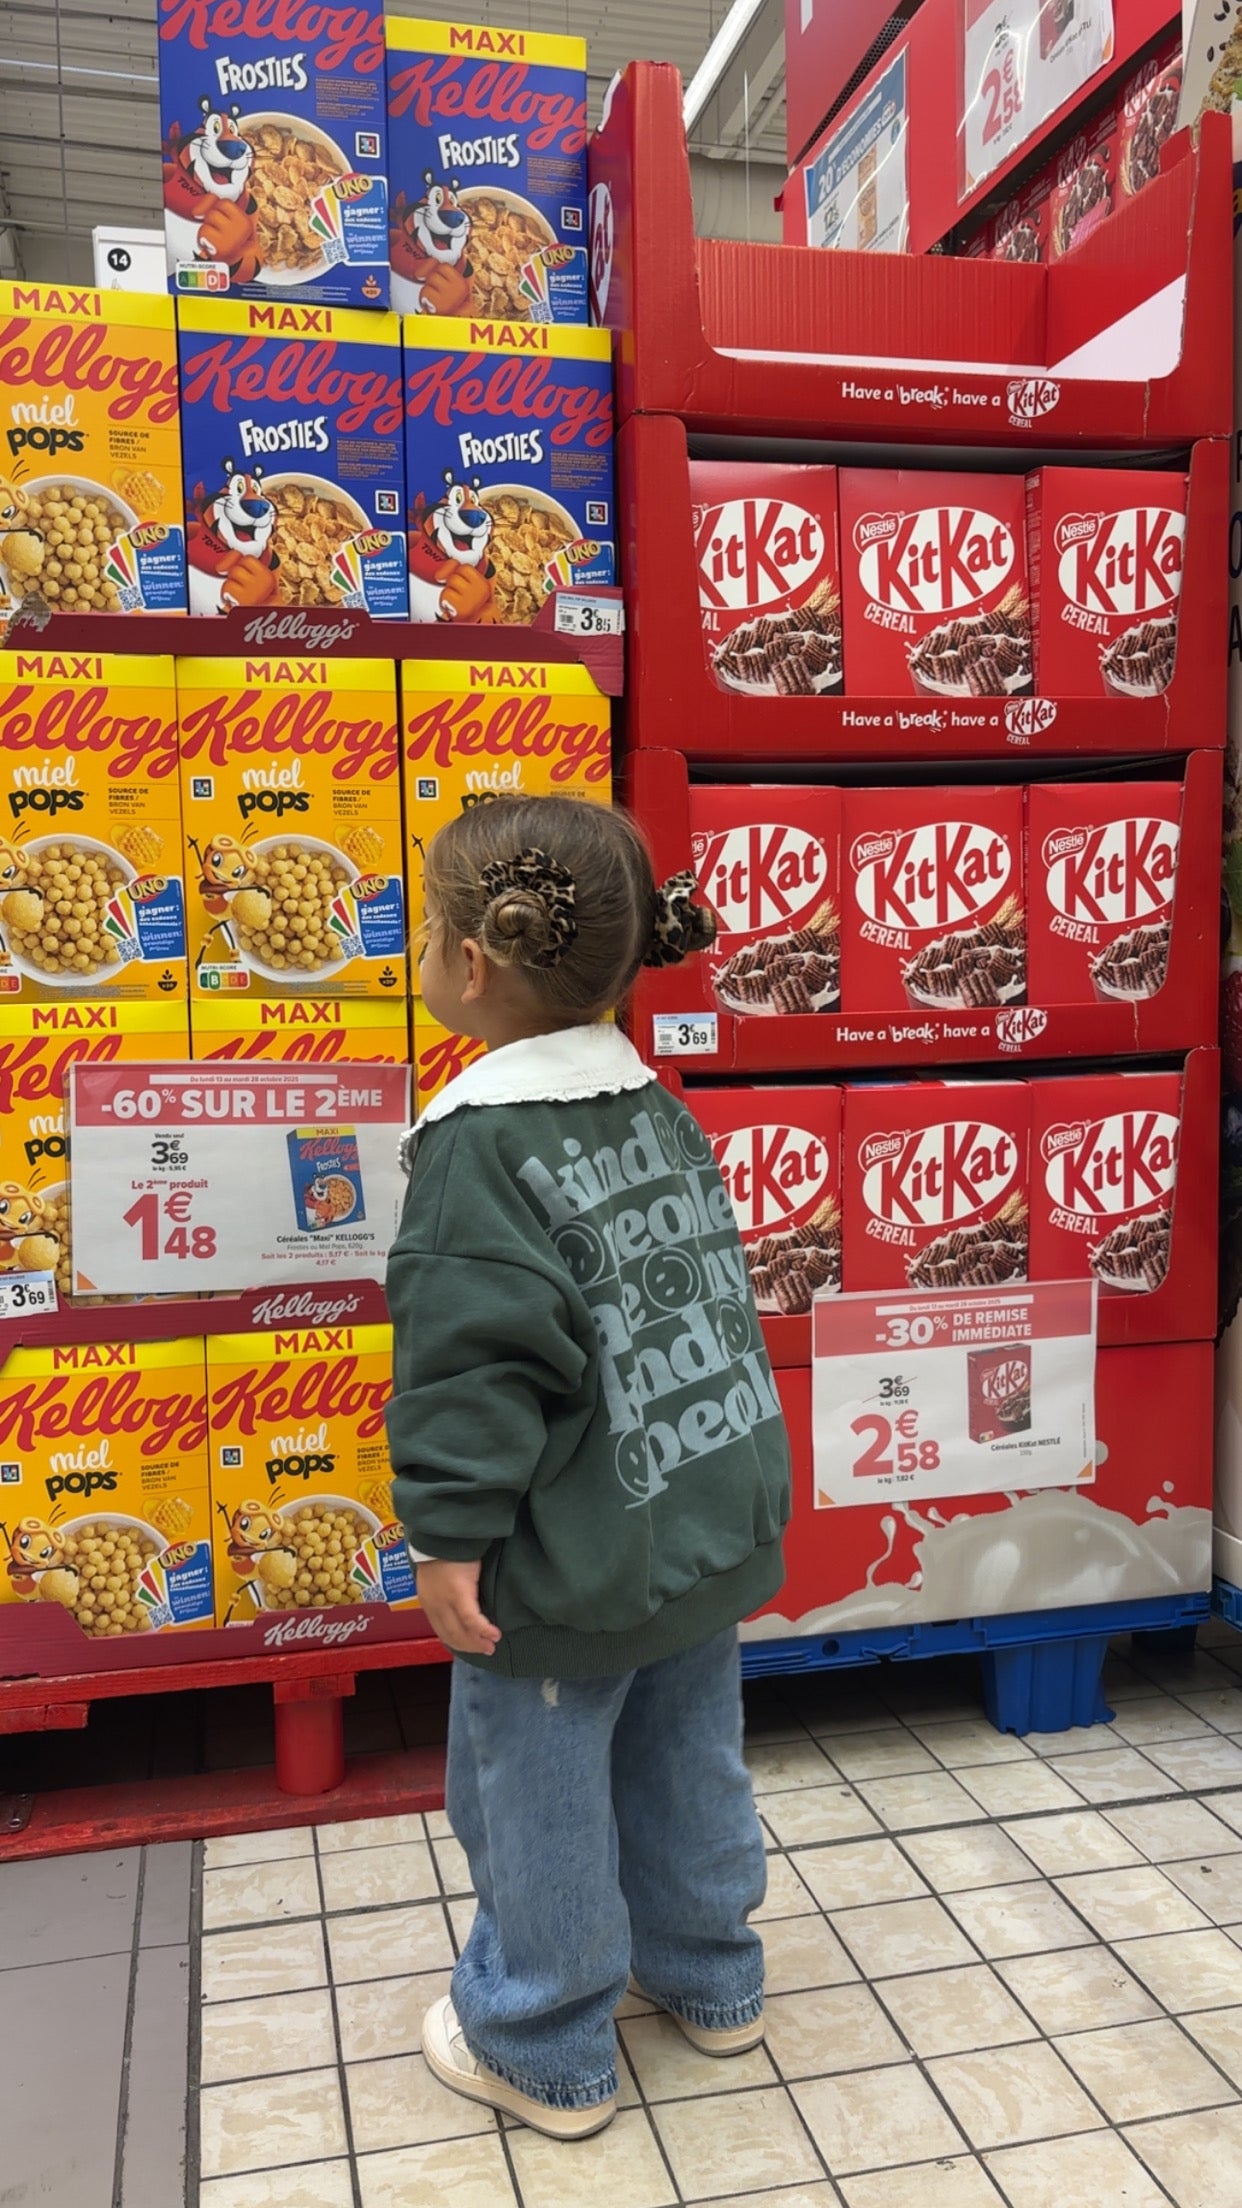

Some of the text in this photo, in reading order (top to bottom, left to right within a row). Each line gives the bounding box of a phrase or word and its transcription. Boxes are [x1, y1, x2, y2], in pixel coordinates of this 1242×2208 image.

[450, 26, 525, 56] MAXI
[215, 53, 308, 96] FROSTIES
[438, 133, 520, 170] FROSTIES
[331, 176, 373, 200] UNO
[111, 253, 128, 267] 14
[13, 287, 102, 316] MAXI
[249, 305, 332, 333] MAXI
[470, 323, 548, 349] MAXI
[11, 394, 79, 427] miel
[842, 382, 881, 400] Have
[884, 388, 894, 400] a
[952, 389, 987, 406] have
[991, 395, 1001, 406] a
[1012, 380, 1058, 416] KitKat
[6, 426, 86, 456] pops
[239, 415, 329, 456] FROSTIES
[458, 429, 543, 469] FROSTIES
[128, 525, 170, 549] UNO
[352, 532, 392, 555] UNO
[564, 542, 600, 565] UNO
[877, 509, 1008, 610] KitKat
[1076, 510, 1182, 612] KitKa
[243, 611, 356, 649] Kellogg's
[863, 602, 917, 633] CEREAL
[1060, 603, 1111, 636] CEREAL
[16, 655, 103, 679] MAXI
[245, 661, 327, 684] MAXI
[470, 665, 547, 688] MAXI
[842, 710, 881, 727] Have
[883, 718, 893, 727] a
[951, 711, 985, 727] have
[989, 717, 999, 726] a
[1010, 699, 1055, 734] KitKat
[13, 755, 79, 788] miel
[242, 758, 305, 790] miel
[465, 761, 525, 791] miel
[8, 788, 85, 819] pops
[108, 787, 149, 795] SOURCE DE
[237, 790, 311, 820] pops
[874, 824, 1004, 928] KitKat
[1065, 821, 1178, 921] KitKa
[126, 876, 168, 901] UNO
[349, 876, 389, 900] UNO
[859, 921, 912, 950] CEREAL
[1049, 915, 1100, 944] CEREAL
[32, 1006, 117, 1029] MAXI
[261, 1002, 341, 1024] MAXI
[836, 1027, 874, 1042] Have
[877, 1030, 886, 1040] a
[943, 1026, 977, 1038] have
[980, 1026, 990, 1036] a
[1001, 1008, 1046, 1043] KitKat
[101, 1084, 383, 1119] -60% SUR LE 2ÈME
[316, 1128, 339, 1136] MAXI
[131, 1180, 144, 1190] Le
[169, 1179, 208, 1191] produit
[516, 1110, 673, 1230] kind
[881, 1124, 1011, 1224] KitKat
[865, 1217, 916, 1247] CEREAL
[1048, 1207, 1099, 1235] CEREAL
[276, 1235, 308, 1243] Céréales
[335, 1233, 375, 1241] KELLOGG'S
[252, 1291, 361, 1325] Kellogg's
[953, 1308, 1028, 1326] DE REMISE
[274, 1329, 353, 1354] MAXI
[875, 1315, 948, 1347] -30%
[952, 1324, 1032, 1342] IMMÉDIATE
[53, 1343, 136, 1370] MAXI
[988, 1361, 1026, 1398] KitKat
[270, 1422, 331, 1455] miel
[50, 1439, 113, 1472] miel
[265, 1454, 336, 1484] pops
[45, 1471, 118, 1501] pops
[157, 1543, 197, 1570] UNO
[264, 1614, 370, 1646] Kellogg's
